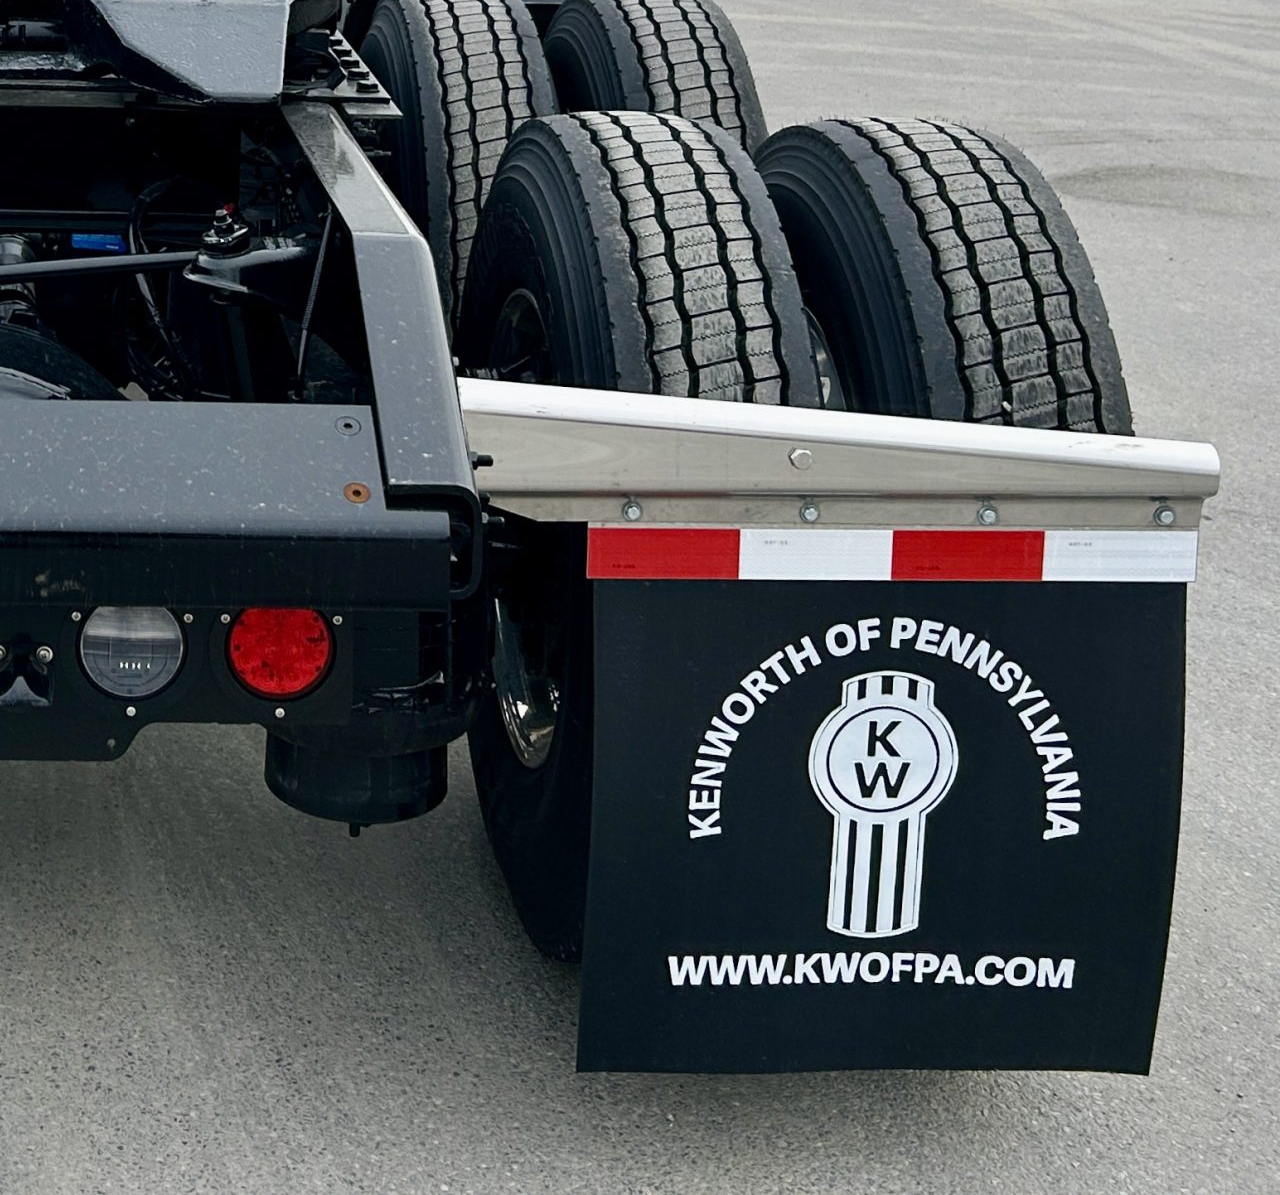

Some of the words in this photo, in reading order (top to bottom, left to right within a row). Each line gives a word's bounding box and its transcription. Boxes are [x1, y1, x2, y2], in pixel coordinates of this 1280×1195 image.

[687, 635, 822, 839] KENWORTH
[825, 617, 881, 657] OF
[890, 616, 1082, 841] PENNSYLVANIA
[867, 720, 902, 758] K
[854, 762, 911, 799] W
[667, 951, 1076, 989] WWW.KWOFPA.COM
